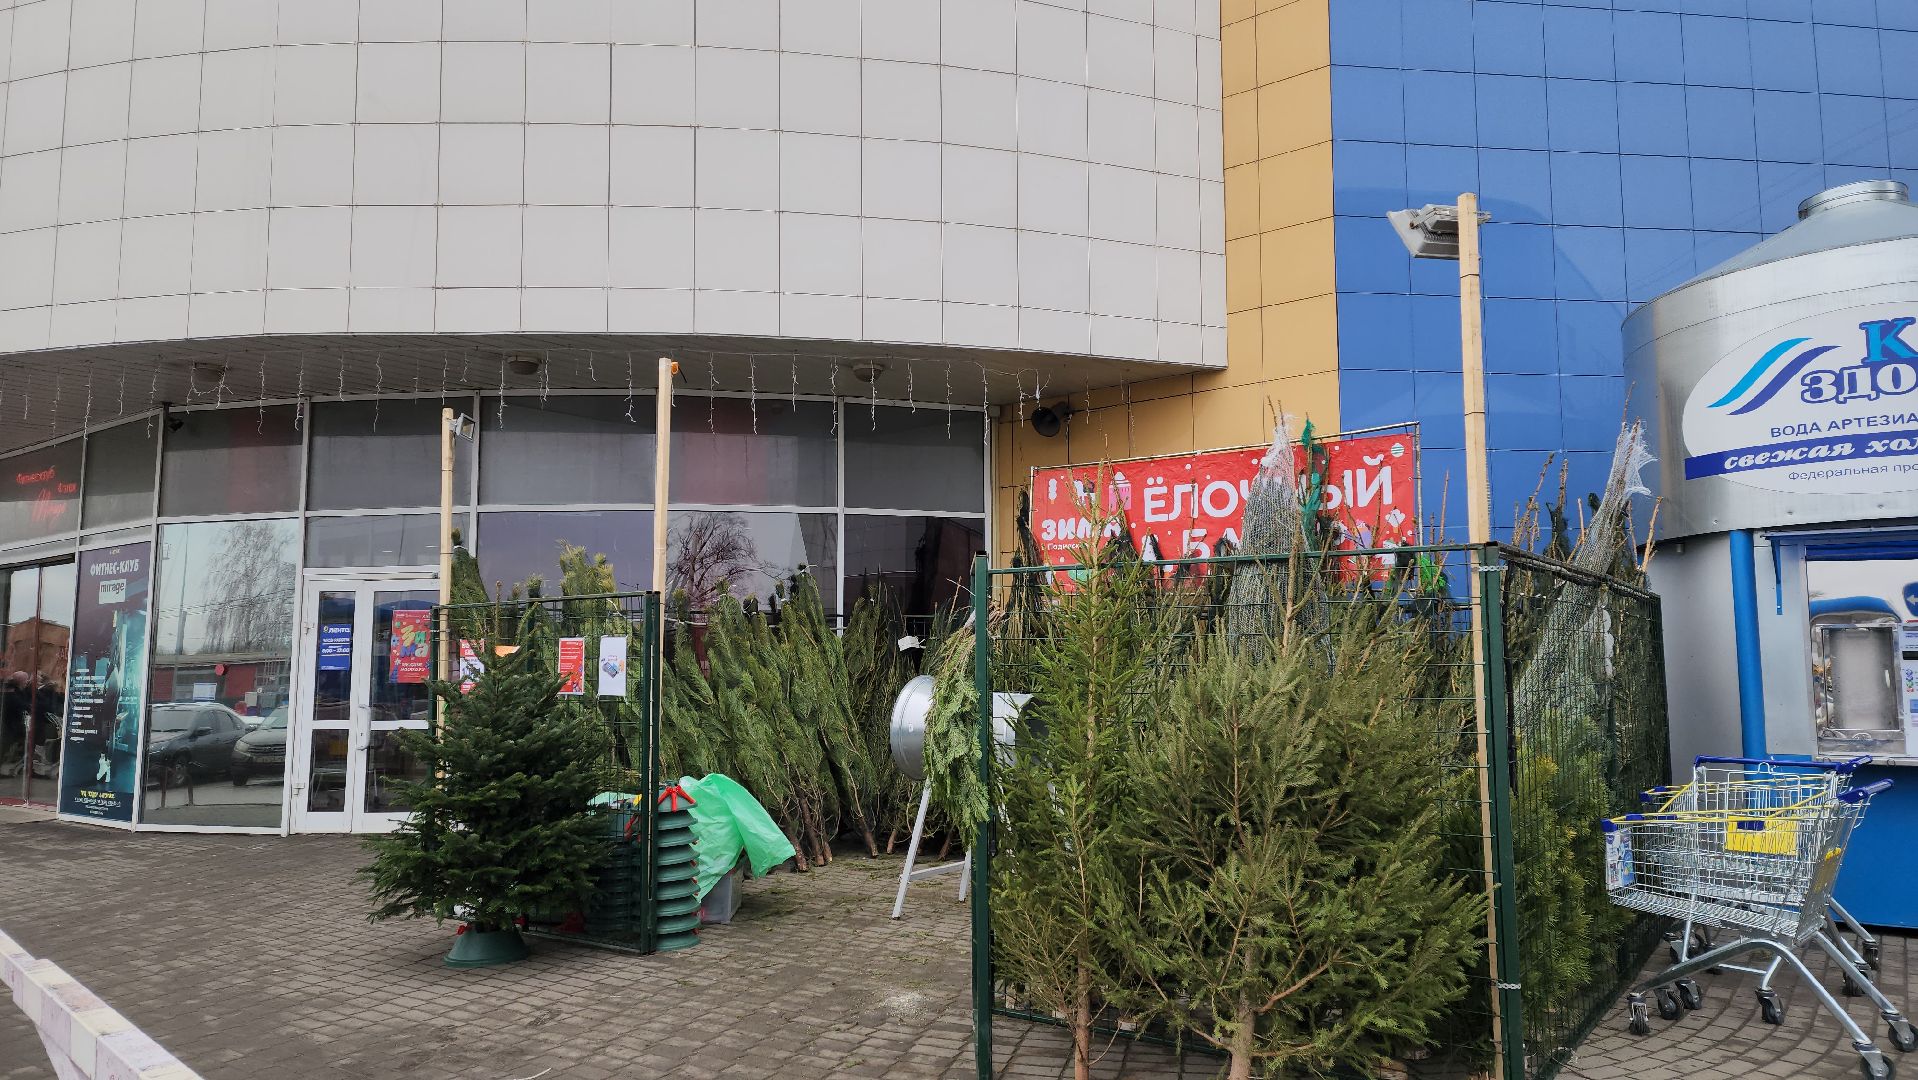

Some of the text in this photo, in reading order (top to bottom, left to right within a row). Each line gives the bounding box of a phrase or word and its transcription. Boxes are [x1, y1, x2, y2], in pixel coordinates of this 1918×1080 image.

[1801, 363, 1918, 404] ЗДО
[1771, 422, 1822, 438] ВОДА
[1724, 442, 1855, 470] свежая
[1788, 464, 1888, 481] Федеральная
[1144, 454, 1393, 523] ЁЛОЫЙ
[90, 559, 139, 577] ФИТНЕС-КЛУБ
[100, 583, 125, 595] mirage
